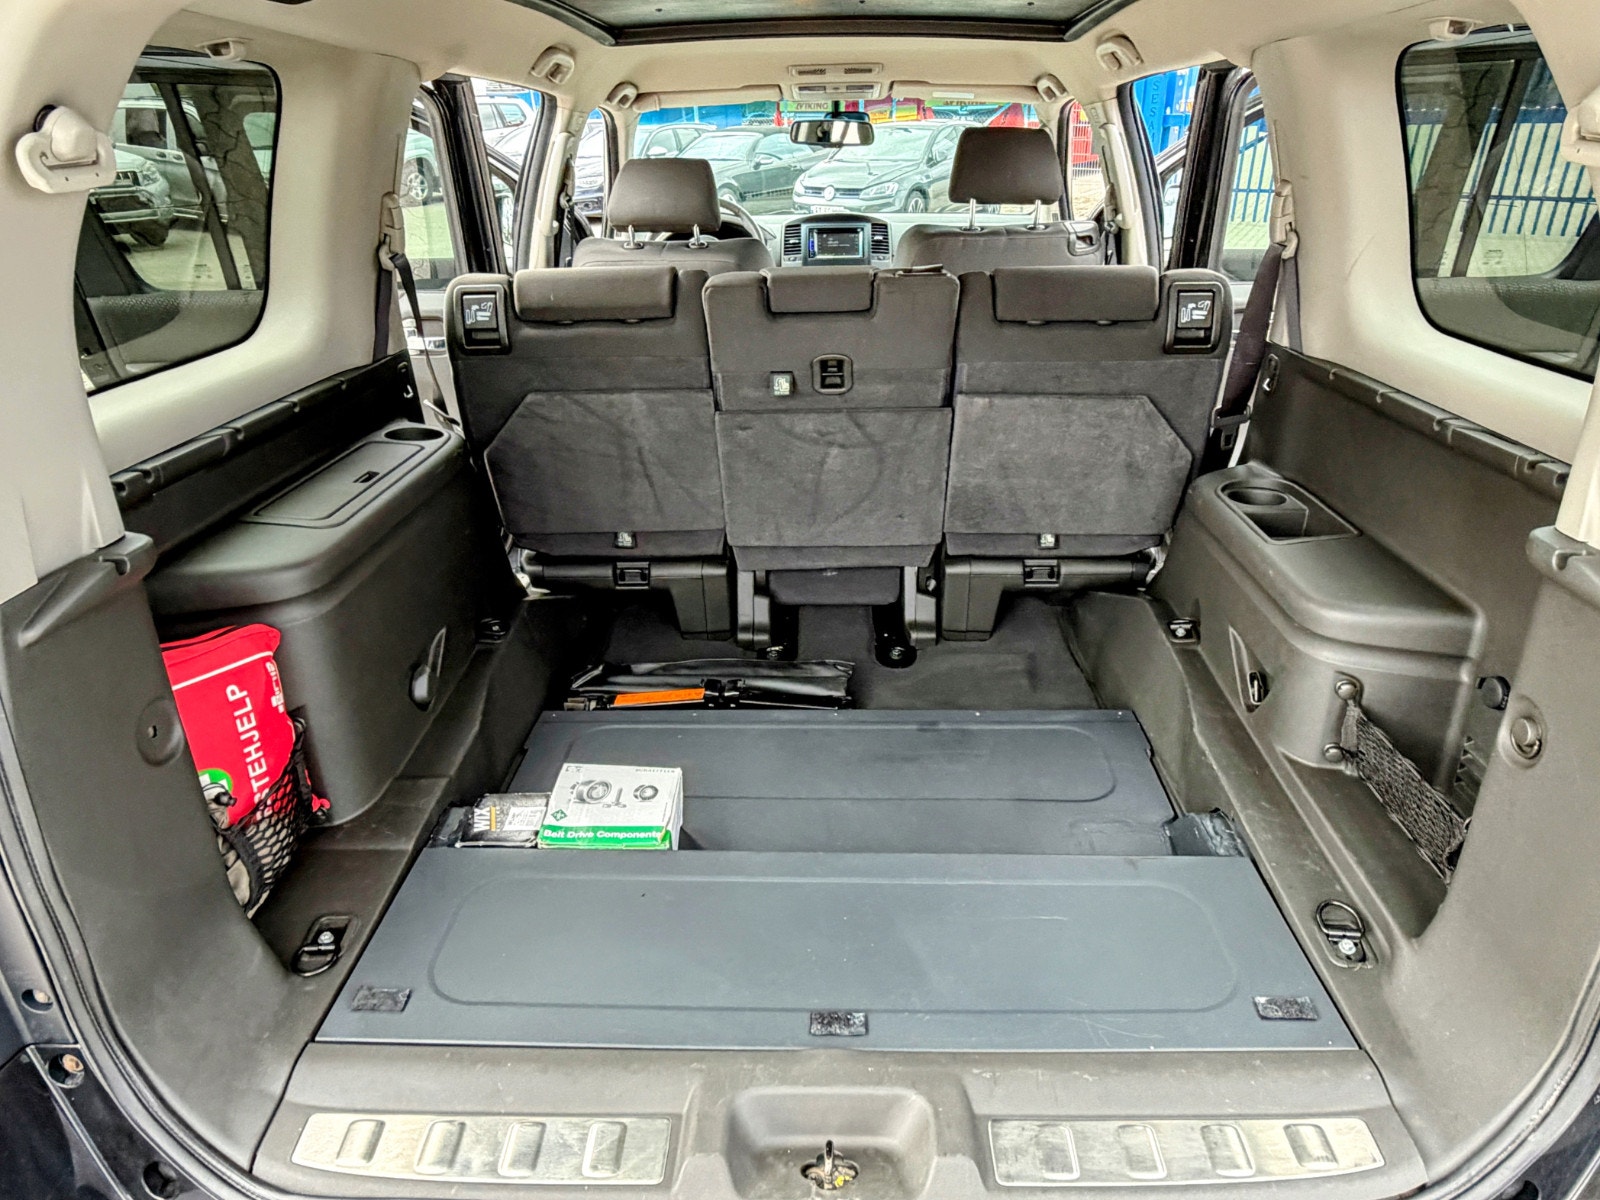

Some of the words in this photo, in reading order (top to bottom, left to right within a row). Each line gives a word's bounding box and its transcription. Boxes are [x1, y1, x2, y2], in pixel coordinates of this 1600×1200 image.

[226, 684, 271, 818] STEHJELP
[473, 806, 491, 832] WIX
[543, 829, 565, 839] Belt
[567, 830, 595, 839] Drive
